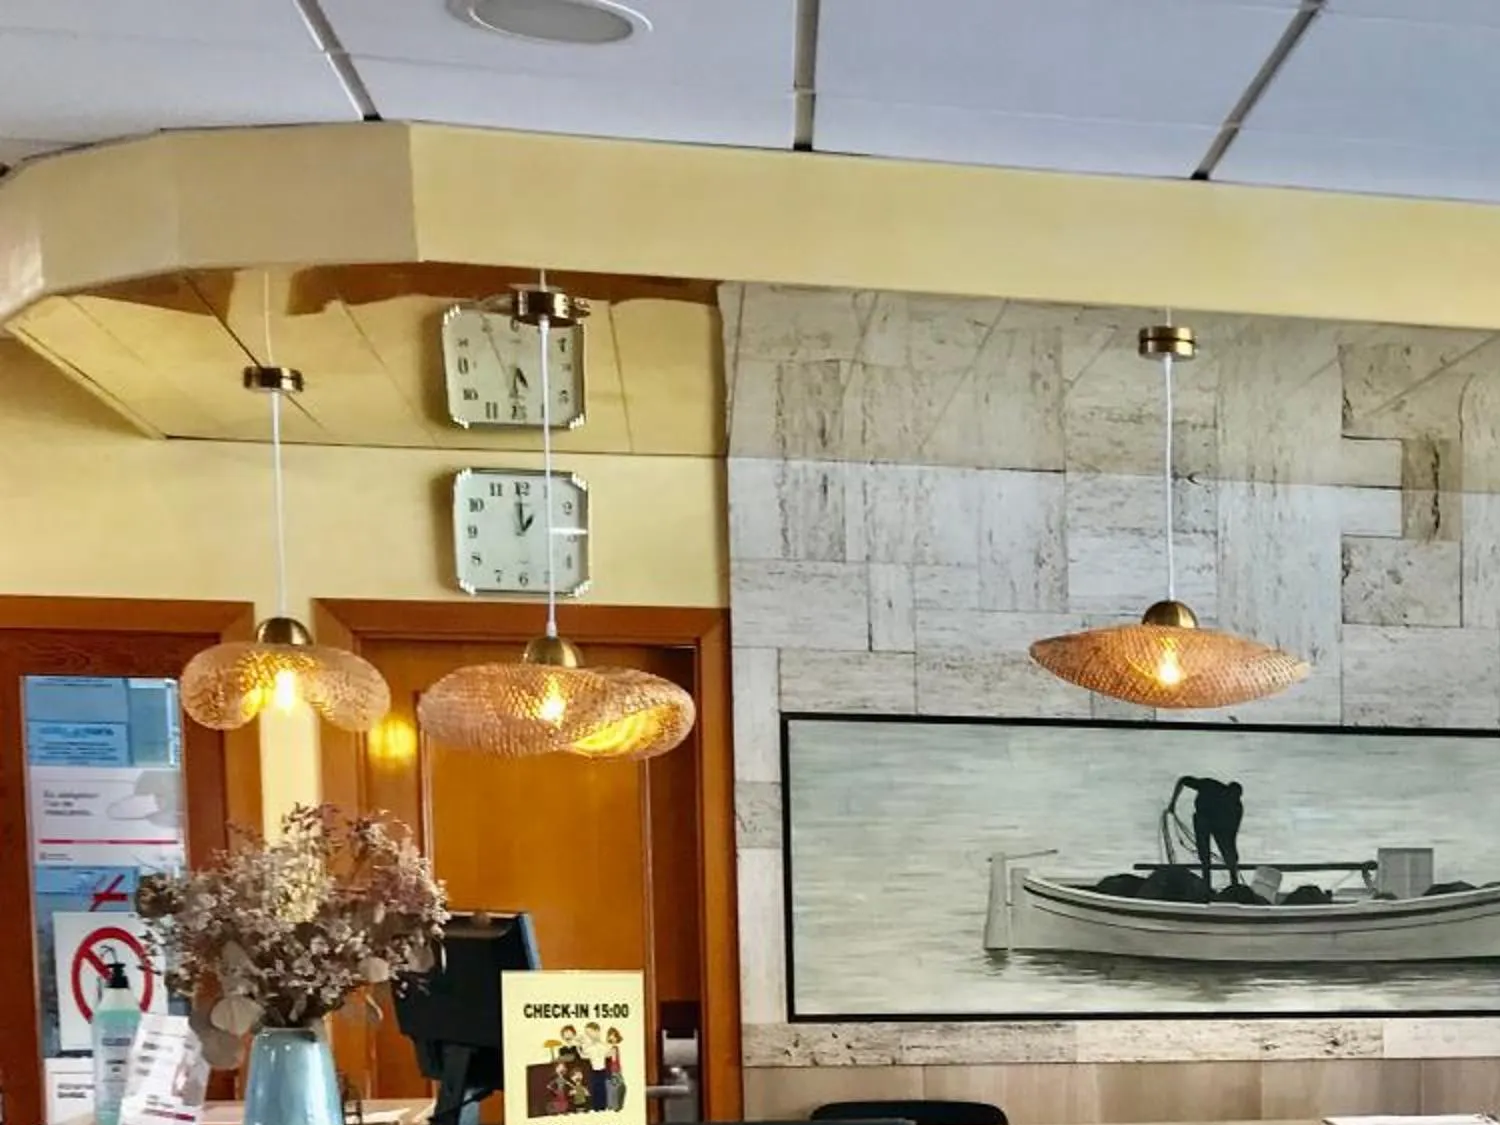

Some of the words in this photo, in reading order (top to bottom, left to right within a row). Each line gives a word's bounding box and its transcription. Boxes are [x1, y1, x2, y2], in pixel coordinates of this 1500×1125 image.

[489, 482, 503, 497] 11
[514, 481, 530, 496] 12
[468, 498, 485, 512] 10
[523, 1003, 590, 1019] CHECK-IN
[594, 1003, 630, 1019] 15:00
